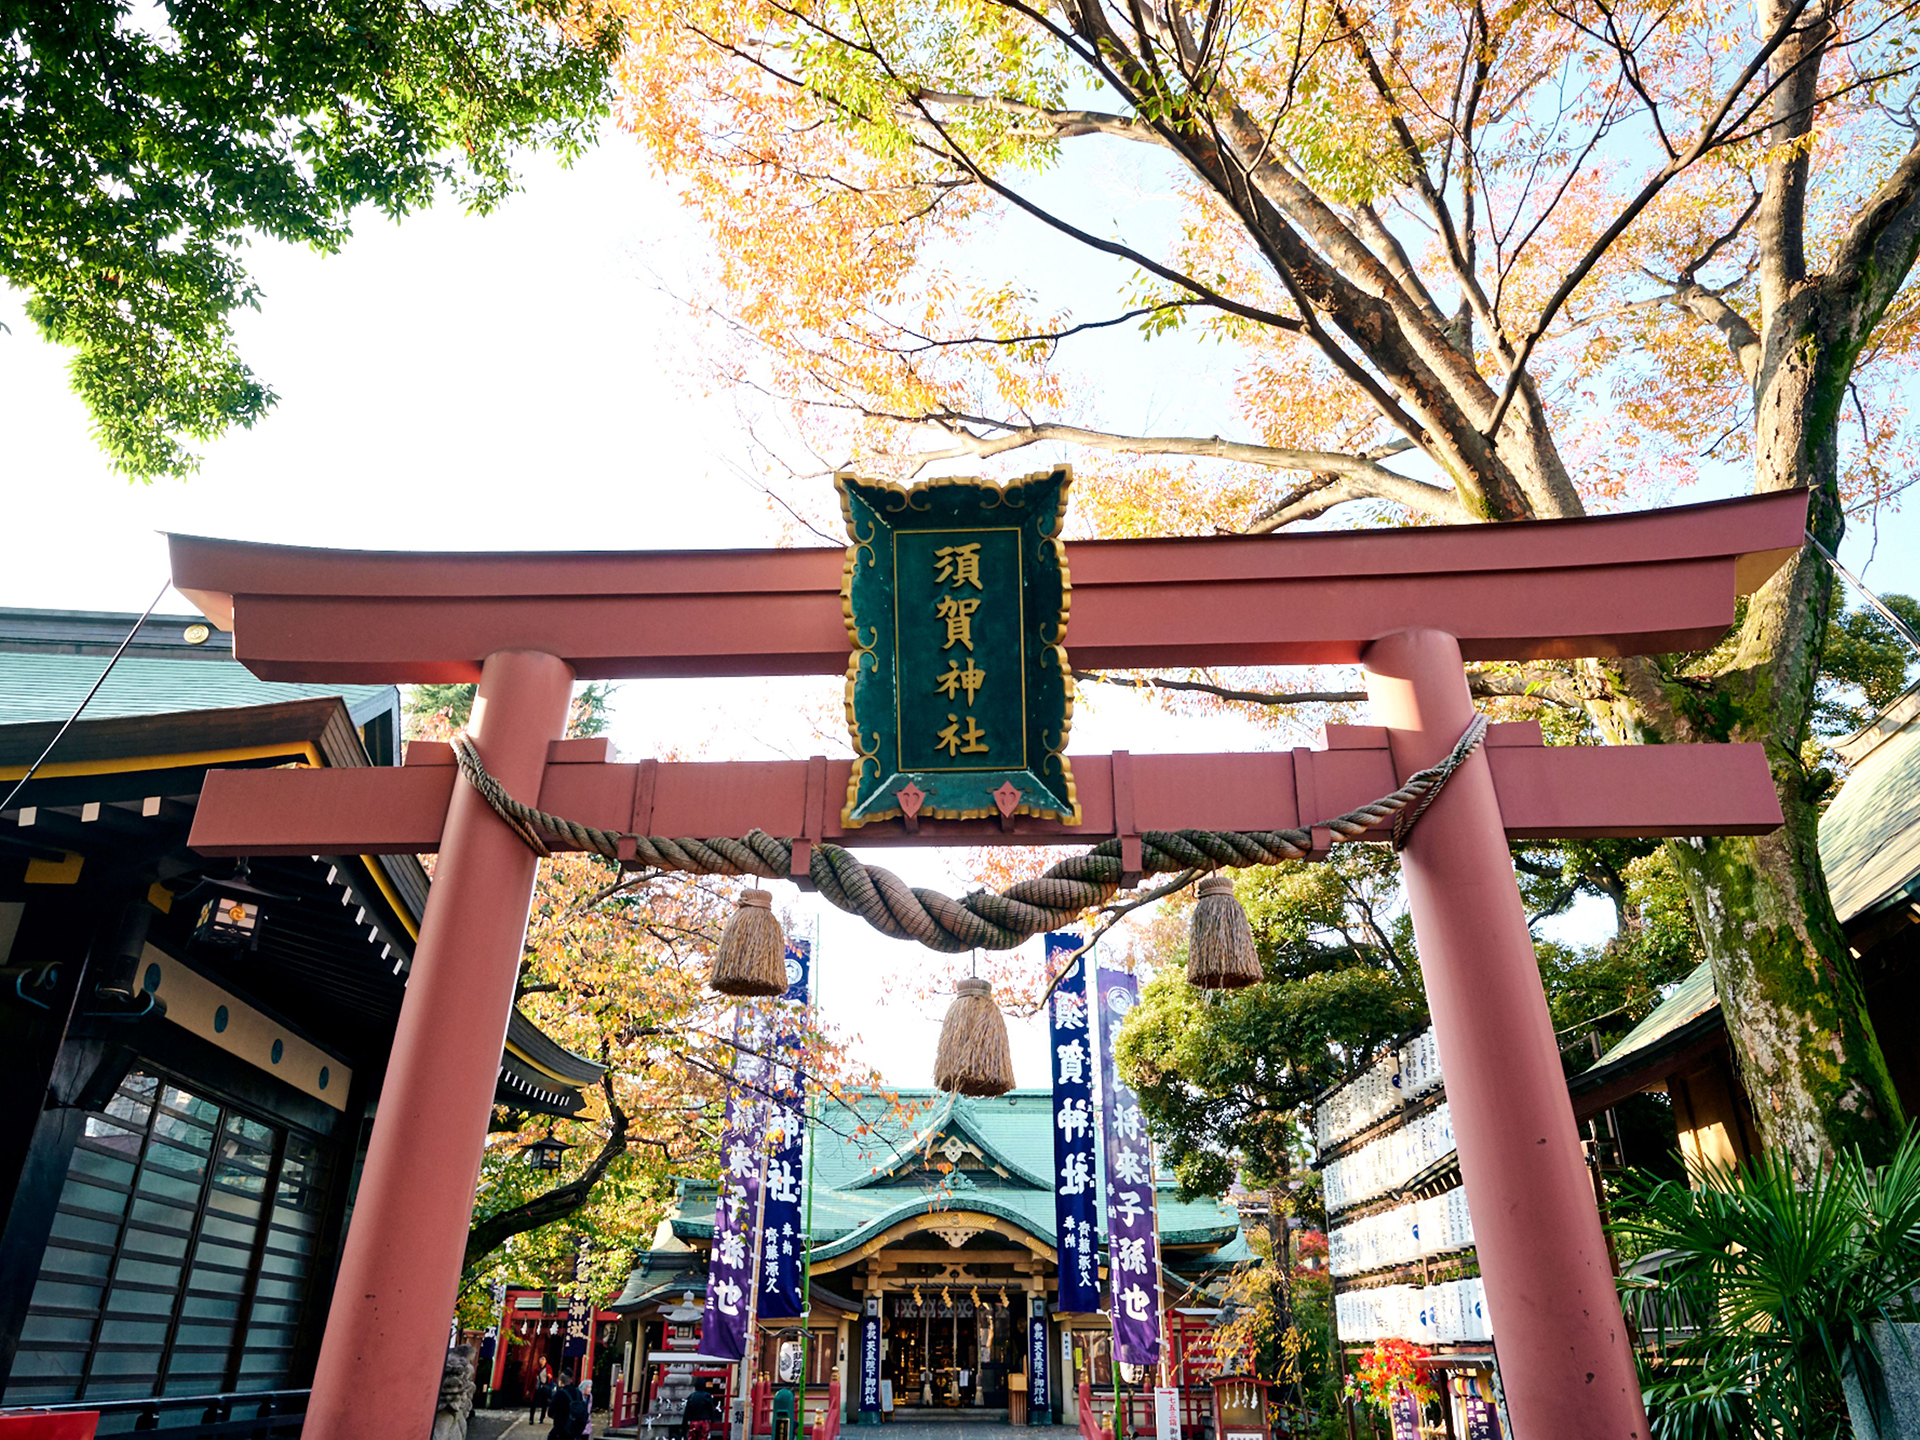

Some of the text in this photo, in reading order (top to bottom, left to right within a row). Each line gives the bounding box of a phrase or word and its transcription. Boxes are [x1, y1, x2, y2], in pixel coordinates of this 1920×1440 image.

[933, 542, 990, 758] 須賀神社
[782, 1222, 794, 1256] 奉納
[864, 1321, 877, 1405] 奉祝 天皇陛下御即位
[1033, 1322, 1045, 1405] 奉祝 天皇陛下御即位
